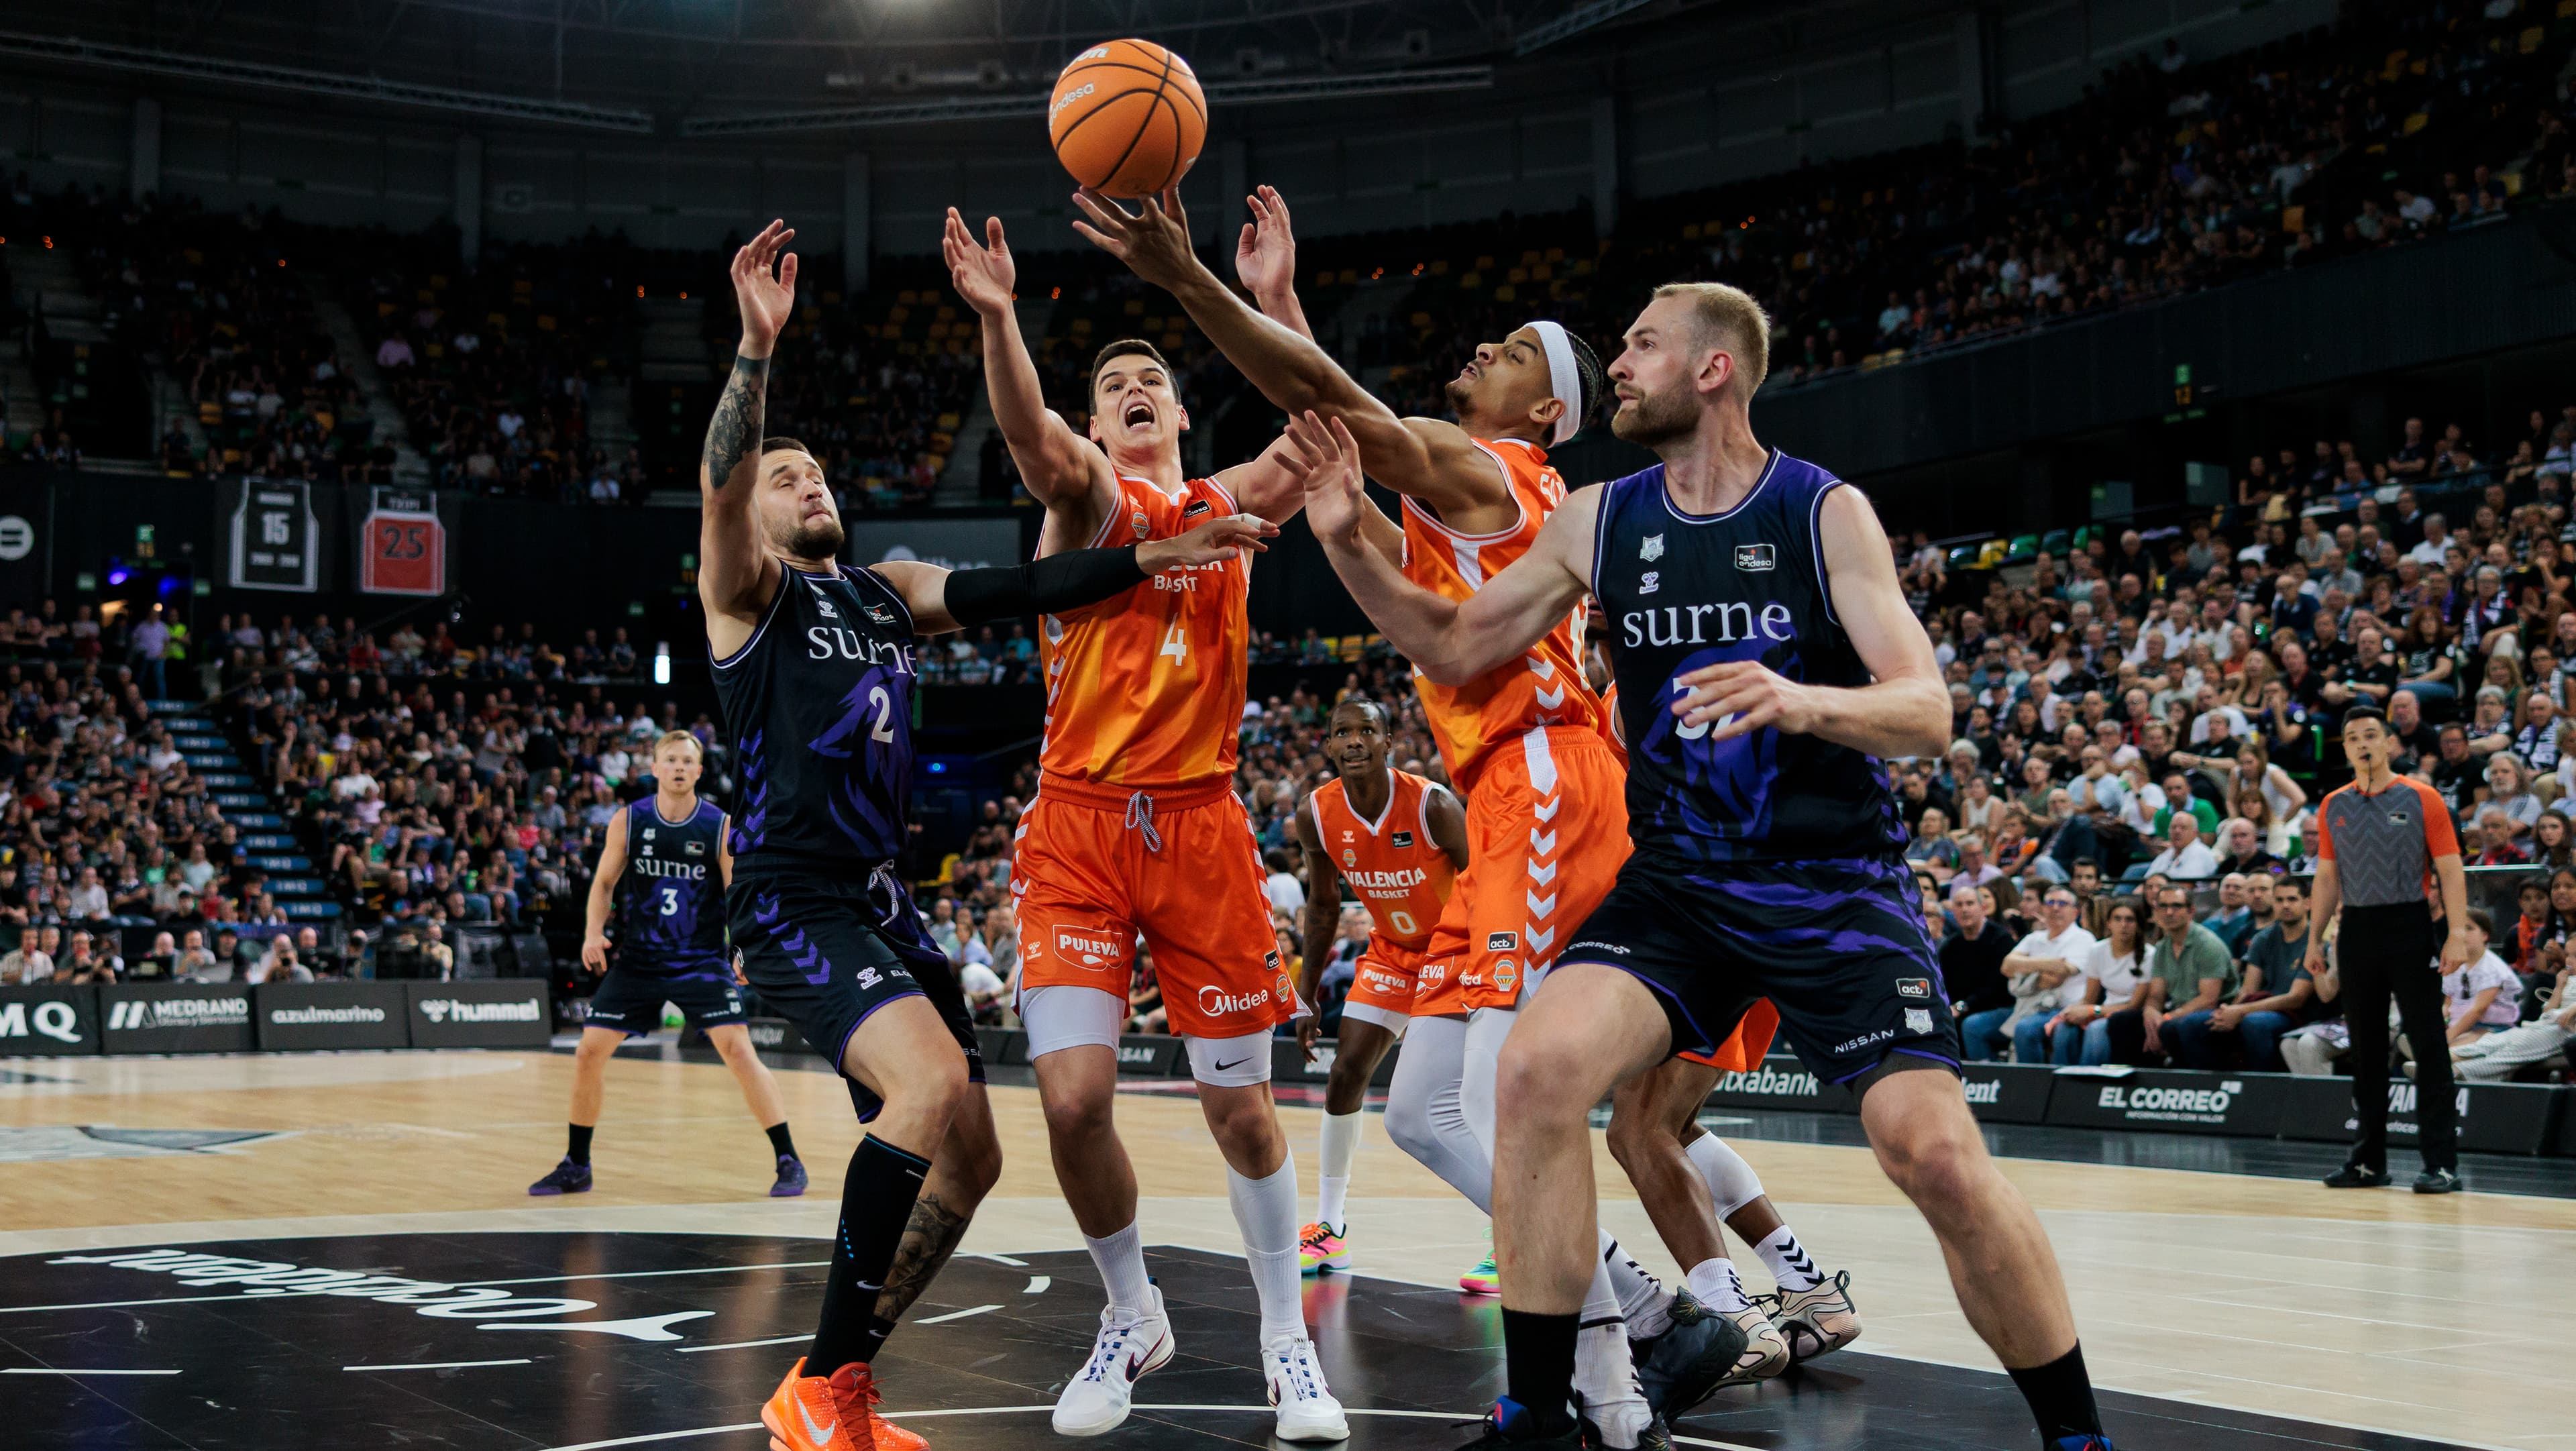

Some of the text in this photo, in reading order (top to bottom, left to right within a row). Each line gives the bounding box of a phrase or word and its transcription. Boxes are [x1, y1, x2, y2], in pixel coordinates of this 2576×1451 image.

[262, 511, 290, 545] 15
[384, 526, 424, 559] 25
[1739, 553, 1754, 561] liga
[1739, 559, 1771, 568] endesa
[1154, 574, 1198, 593] BASKT
[1623, 602, 1792, 648] surne
[1160, 612, 1187, 667] 4
[869, 686, 894, 744] 2
[635, 857, 706, 881] surne
[1343, 867, 1427, 888] VALENCIA
[661, 888, 678, 916] 3
[1367, 889, 1410, 899] BASKET
[1390, 911, 1417, 934] 0
[1059, 934, 1120, 957] PULEVA
[1490, 936, 1510, 949] acb
[1568, 941, 1624, 955] CORREO
[1362, 969, 1406, 989] PULEVA
[1418, 965, 1444, 979] LEVA
[1209, 989, 1269, 1014] Midea
[1902, 985, 1923, 995] acb
[153, 998, 248, 1017] MEDRANO
[271, 1006, 386, 1024] azulmarino
[451, 999, 541, 1022] hummel
[1835, 1029, 1894, 1053] NISSAN
[1714, 1065, 1819, 1097] txabank
[2098, 1086, 2231, 1114] EL CORREO
